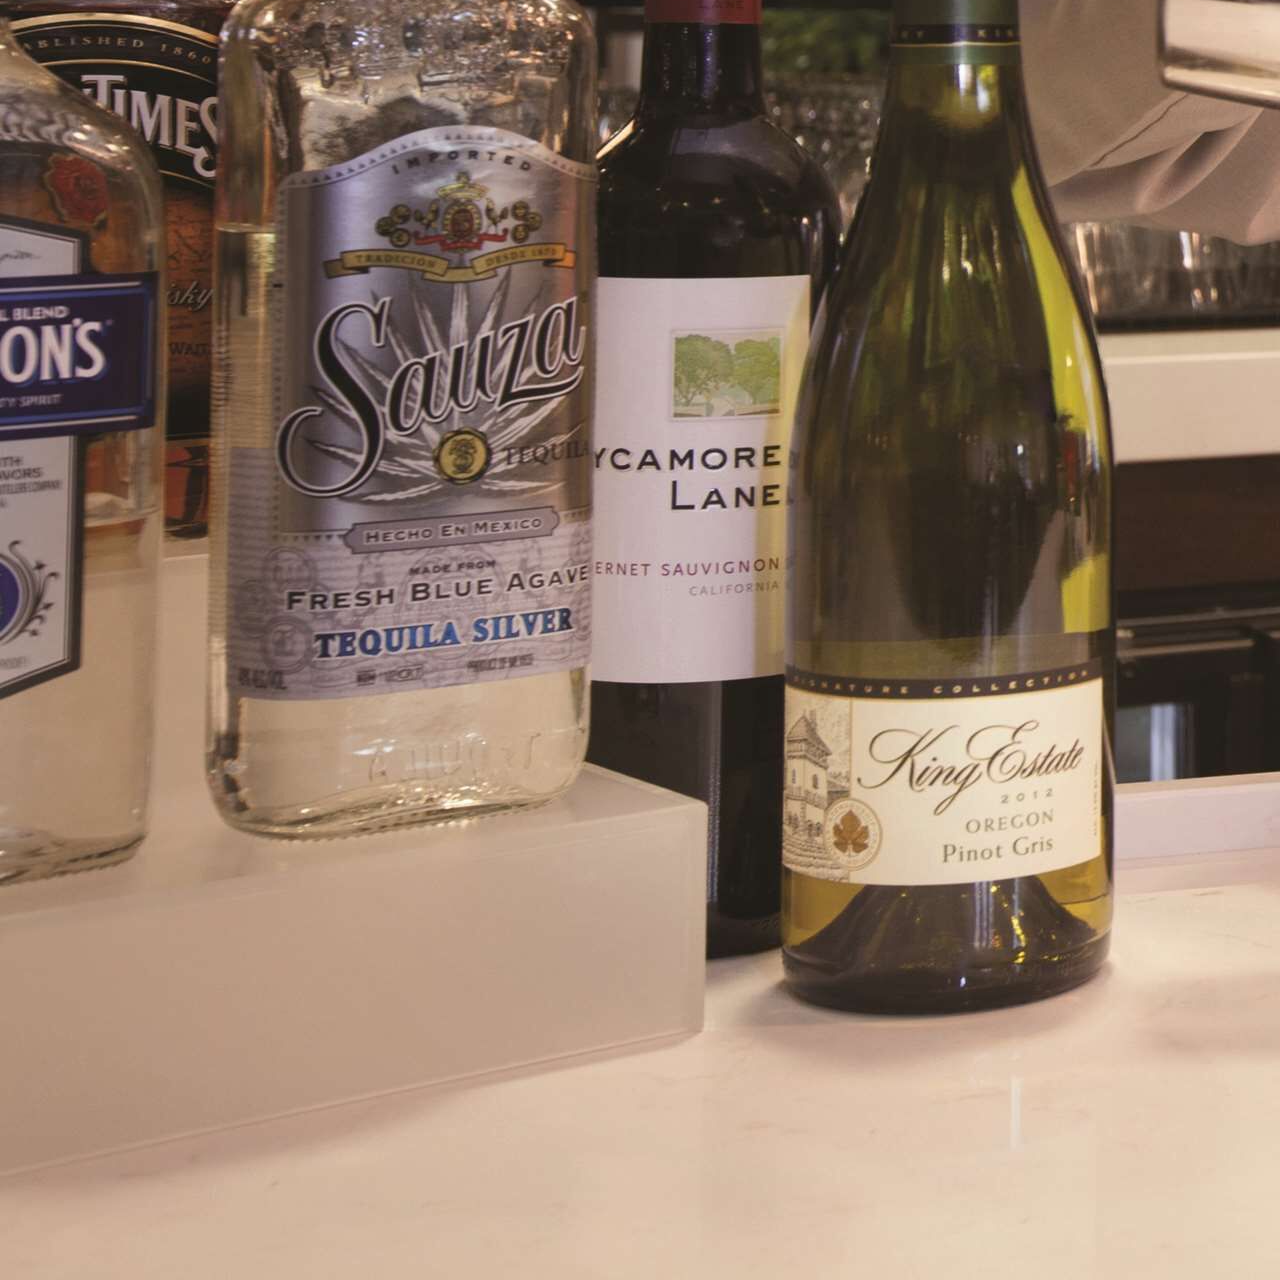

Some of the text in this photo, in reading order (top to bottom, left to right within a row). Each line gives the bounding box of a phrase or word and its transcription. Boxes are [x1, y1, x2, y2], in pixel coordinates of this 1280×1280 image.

[160, 43, 212, 64] 1860
[392, 150, 532, 174] IMPORTED
[12, 305, 69, 321] BLEND
[277, 296, 588, 498] Sauza
[671, 480, 780, 511] LANE
[366, 529, 432, 544] HECHO
[474, 518, 542, 534] MEXICO
[409, 559, 497, 575] MADE FROM
[661, 558, 779, 577] SAUVIGNON
[287, 565, 589, 610] FRESH BLUE AGAVE
[689, 581, 779, 597] CALIFORNIA
[314, 608, 574, 659] TEQUILA SILVER
[857, 720, 1084, 815] King Estate
[1001, 788, 1053, 804] 2012
[965, 809, 1054, 835] OREGON
[942, 836, 1053, 863] Pinot Gris
